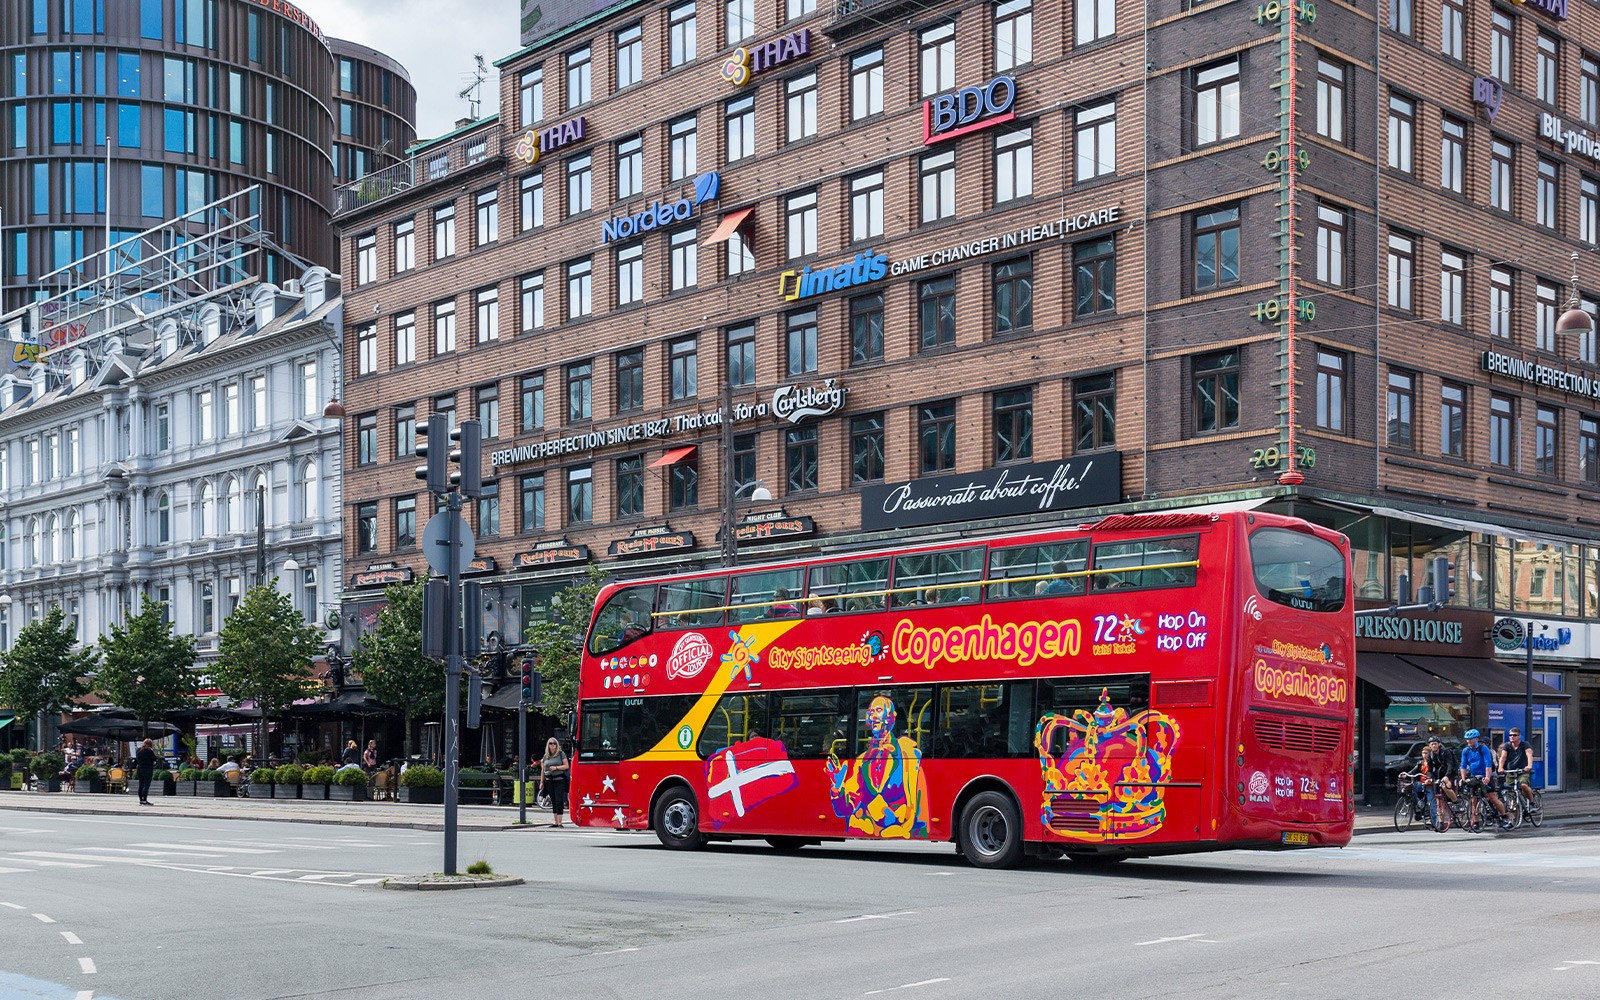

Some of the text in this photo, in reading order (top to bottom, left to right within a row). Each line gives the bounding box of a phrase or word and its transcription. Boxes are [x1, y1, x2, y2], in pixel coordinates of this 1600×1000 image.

[750, 28, 810, 72] THAI
[934, 75, 1016, 131] BDO
[1474, 77, 1497, 108] BIL
[538, 117, 586, 151] THAI
[601, 199, 693, 243] Nordea
[891, 206, 1120, 276] GAME CHANGER IN HEALTHCARE
[799, 249, 889, 299] imatis
[1488, 351, 1534, 380] BREWING
[1536, 364, 1591, 396] PERFECTION
[491, 443, 539, 467] BREWING
[540, 430, 606, 457] PERFECTION
[608, 422, 641, 445] SINCE
[643, 418, 671, 438] 1847.
[675, 413, 703, 432] That
[736, 403, 753, 420] for
[757, 403, 766, 416] a
[772, 379, 846, 424] Carlsberg
[883, 460, 1093, 514] Passionate about coffee!
[892, 613, 1082, 669] Copenhagen
[1093, 613, 1119, 643] 72
[1156, 631, 1208, 652] Hop Off
[1157, 610, 1206, 631] Hop On
[1355, 616, 1463, 644] PRESSO HOUSE
[672, 645, 711, 671] OFFICIAL
[1254, 659, 1347, 705] Copenhagen
[1249, 794, 1270, 803] MAN
[1300, 777, 1310, 792] 72
